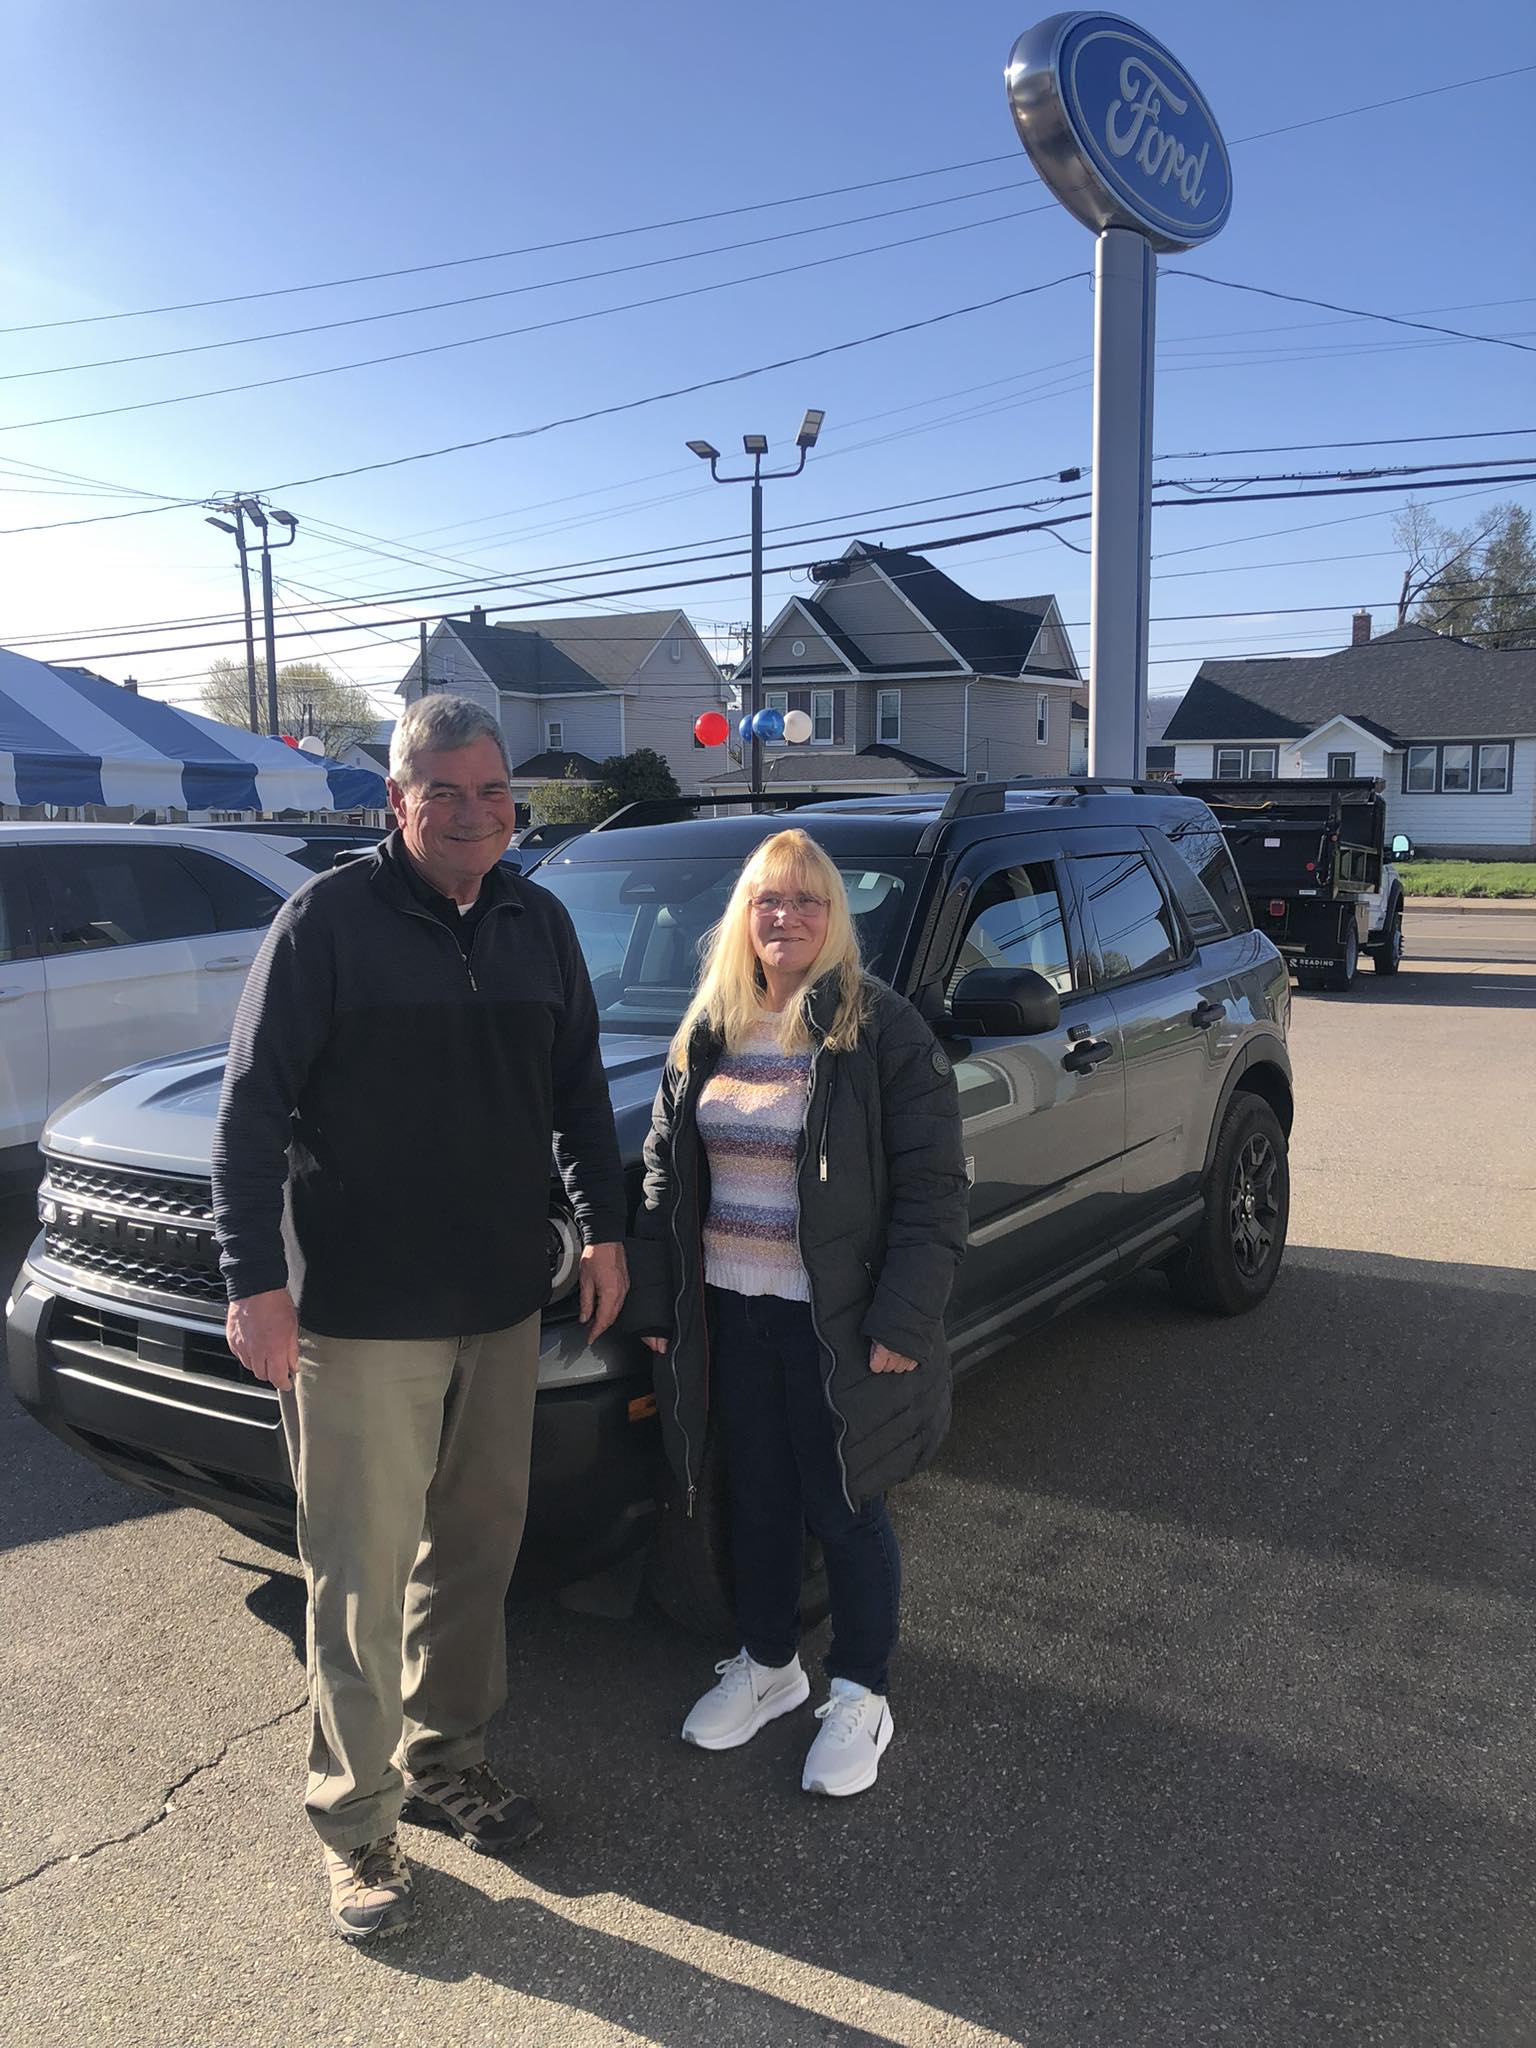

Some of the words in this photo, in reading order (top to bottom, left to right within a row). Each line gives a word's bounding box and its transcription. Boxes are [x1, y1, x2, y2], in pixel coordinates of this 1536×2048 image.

[1106, 56, 1209, 209] Ford
[1299, 958, 1334, 967] READING
[61, 1205, 217, 1253] BRON
